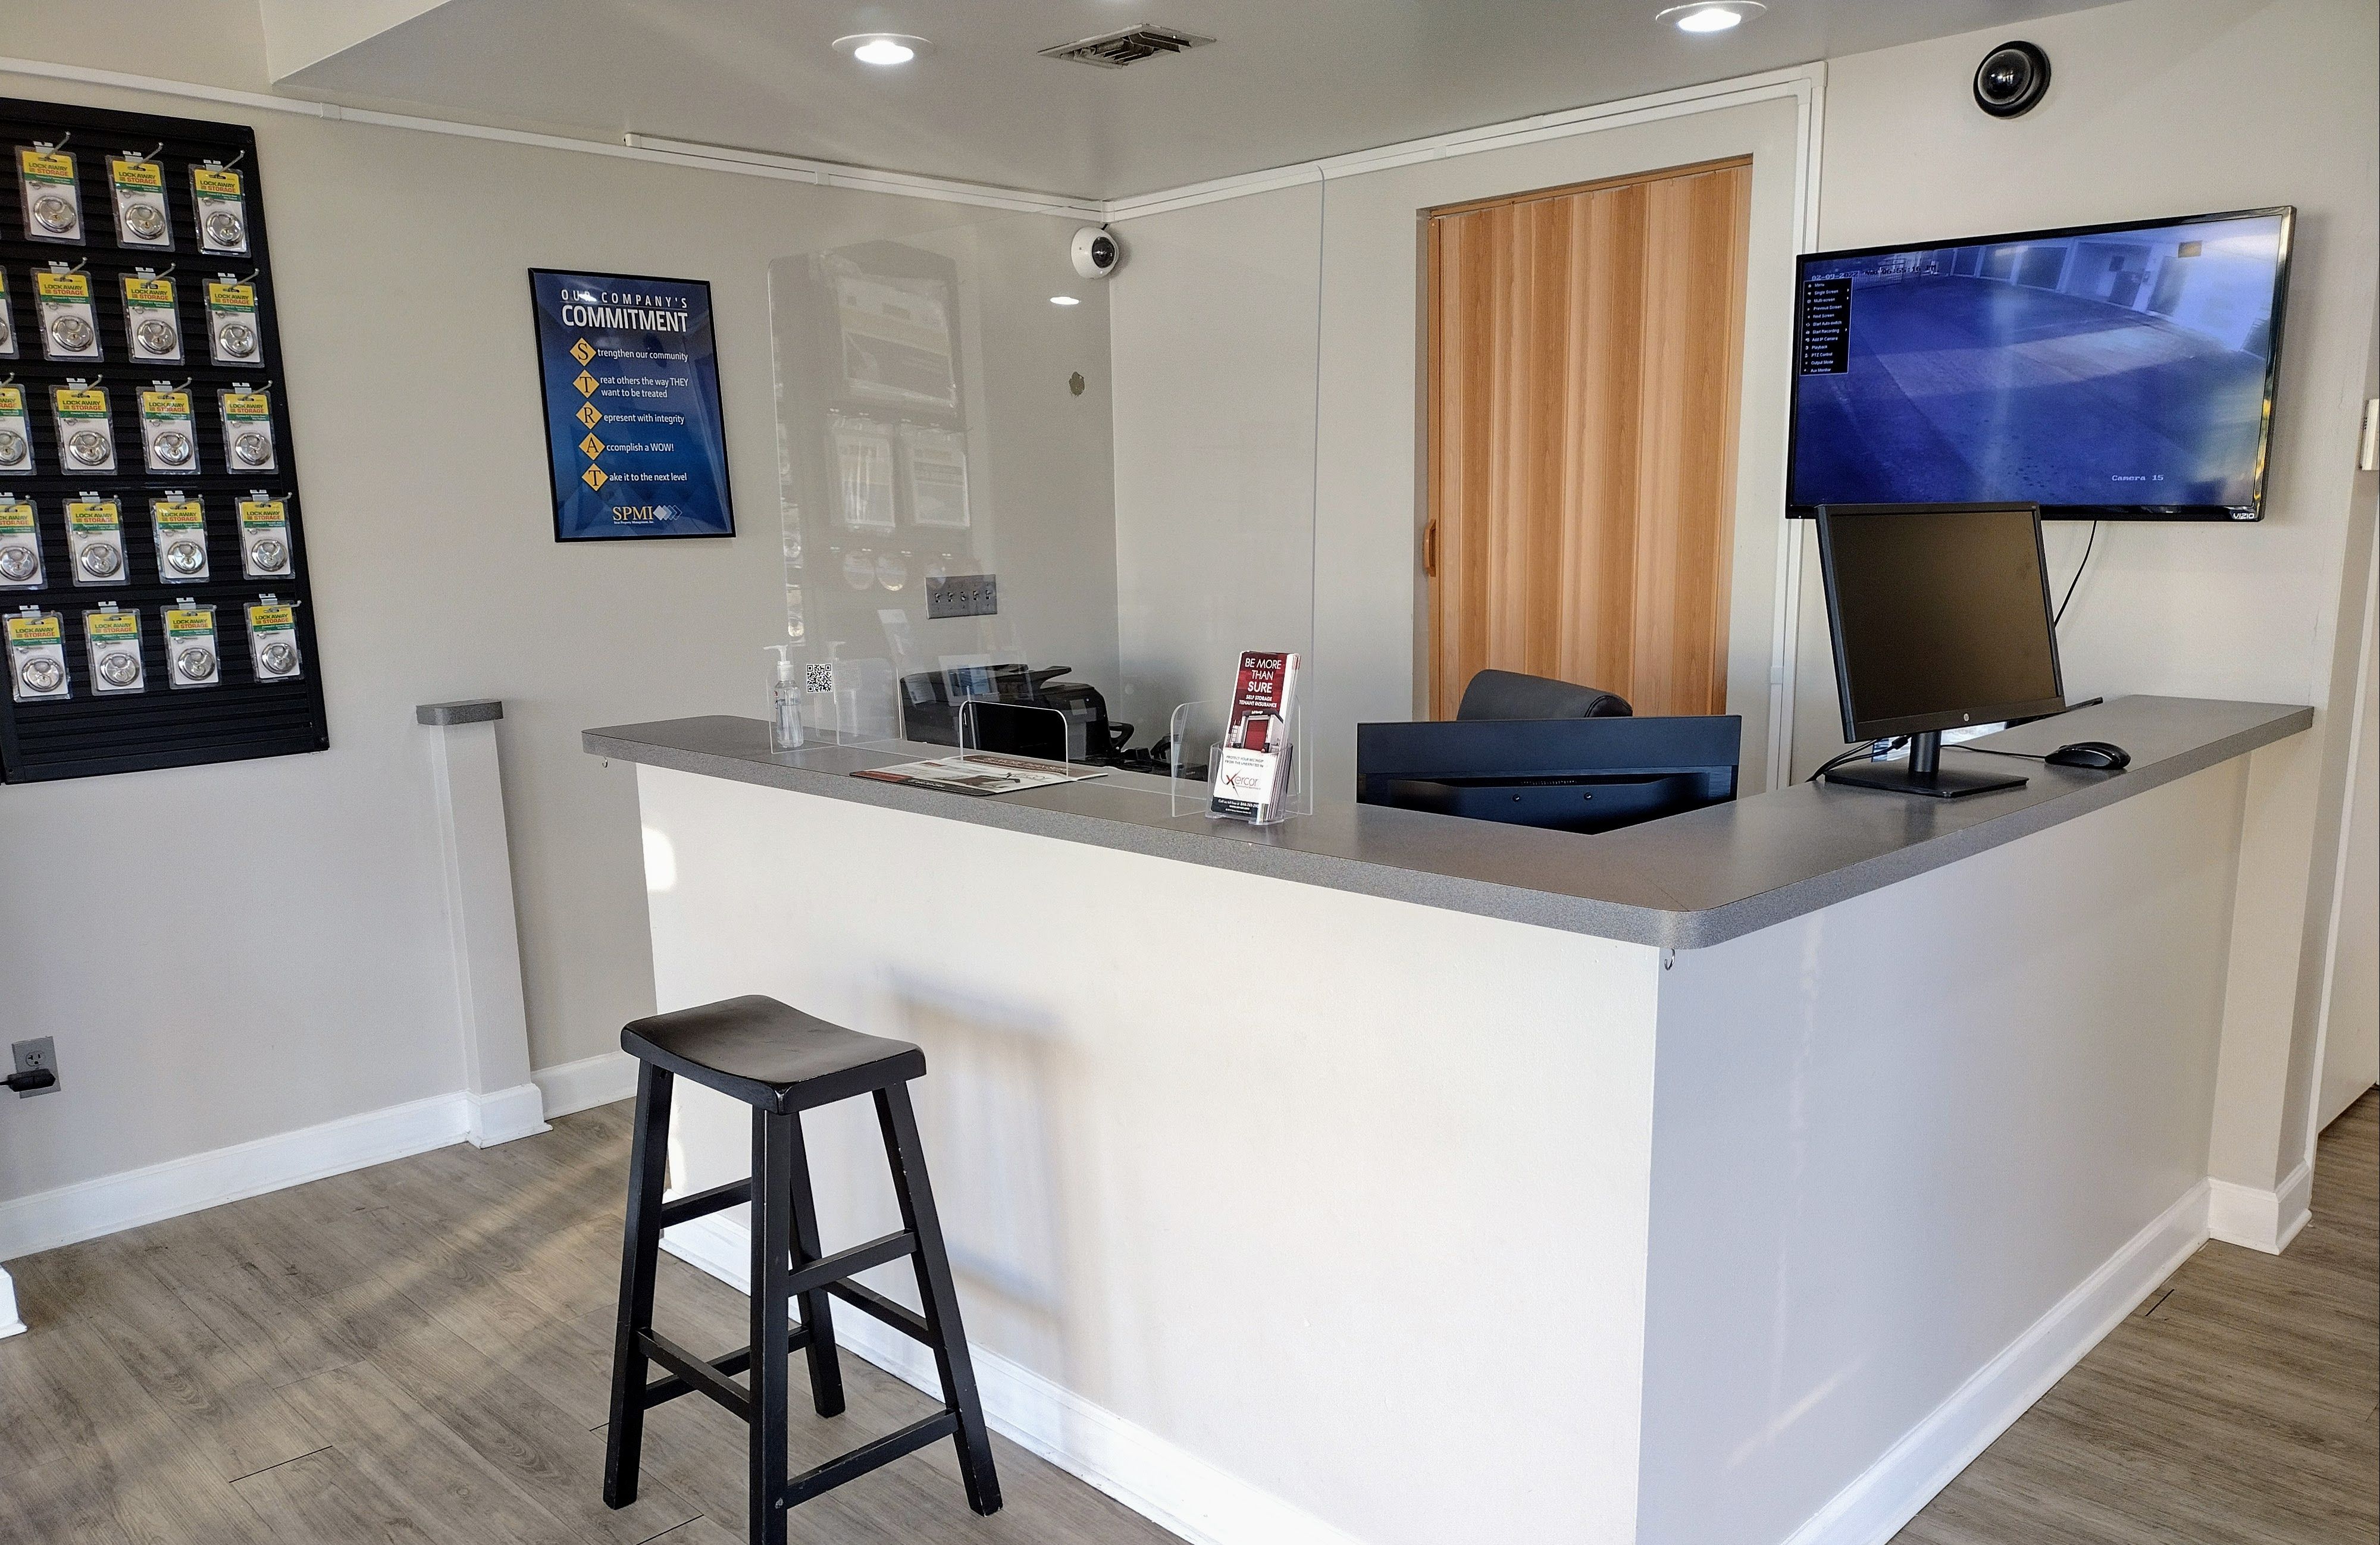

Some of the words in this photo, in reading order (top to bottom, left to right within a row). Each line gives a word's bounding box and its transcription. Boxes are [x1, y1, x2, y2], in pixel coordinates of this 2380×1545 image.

[37, 168, 68, 176] STORAGE
[602, 292, 687, 308] COMPANY'S
[562, 305, 688, 332] COMMITMENT
[578, 343, 588, 360] S
[597, 349, 634, 359] trengthen
[649, 352, 688, 362] community
[579, 377, 593, 393] T
[600, 376, 615, 384] reat
[616, 375, 640, 385] others
[641, 376, 653, 386] the
[655, 378, 669, 388] way
[669, 378, 688, 387] THEY
[601, 388, 620, 397] want
[631, 388, 640, 397] be
[641, 389, 668, 398] treated
[584, 407, 595, 424] R
[603, 414, 635, 424] epresent
[637, 413, 653, 422] with
[654, 414, 685, 425] integrity
[586, 437, 599, 453] A
[606, 443, 643, 453] ccomplish
[650, 443, 674, 452] WOW!
[588, 470, 601, 486] T
[624, 472, 630, 481] it
[671, 472, 687, 481] level
[613, 506, 654, 521] SPMI
[1245, 657, 1255, 667] BE
[1257, 659, 1282, 669] MORE
[1252, 670, 1273, 681] THAN
[1248, 681, 1273, 693] SURE
[1226, 771, 1259, 788] Xercor
